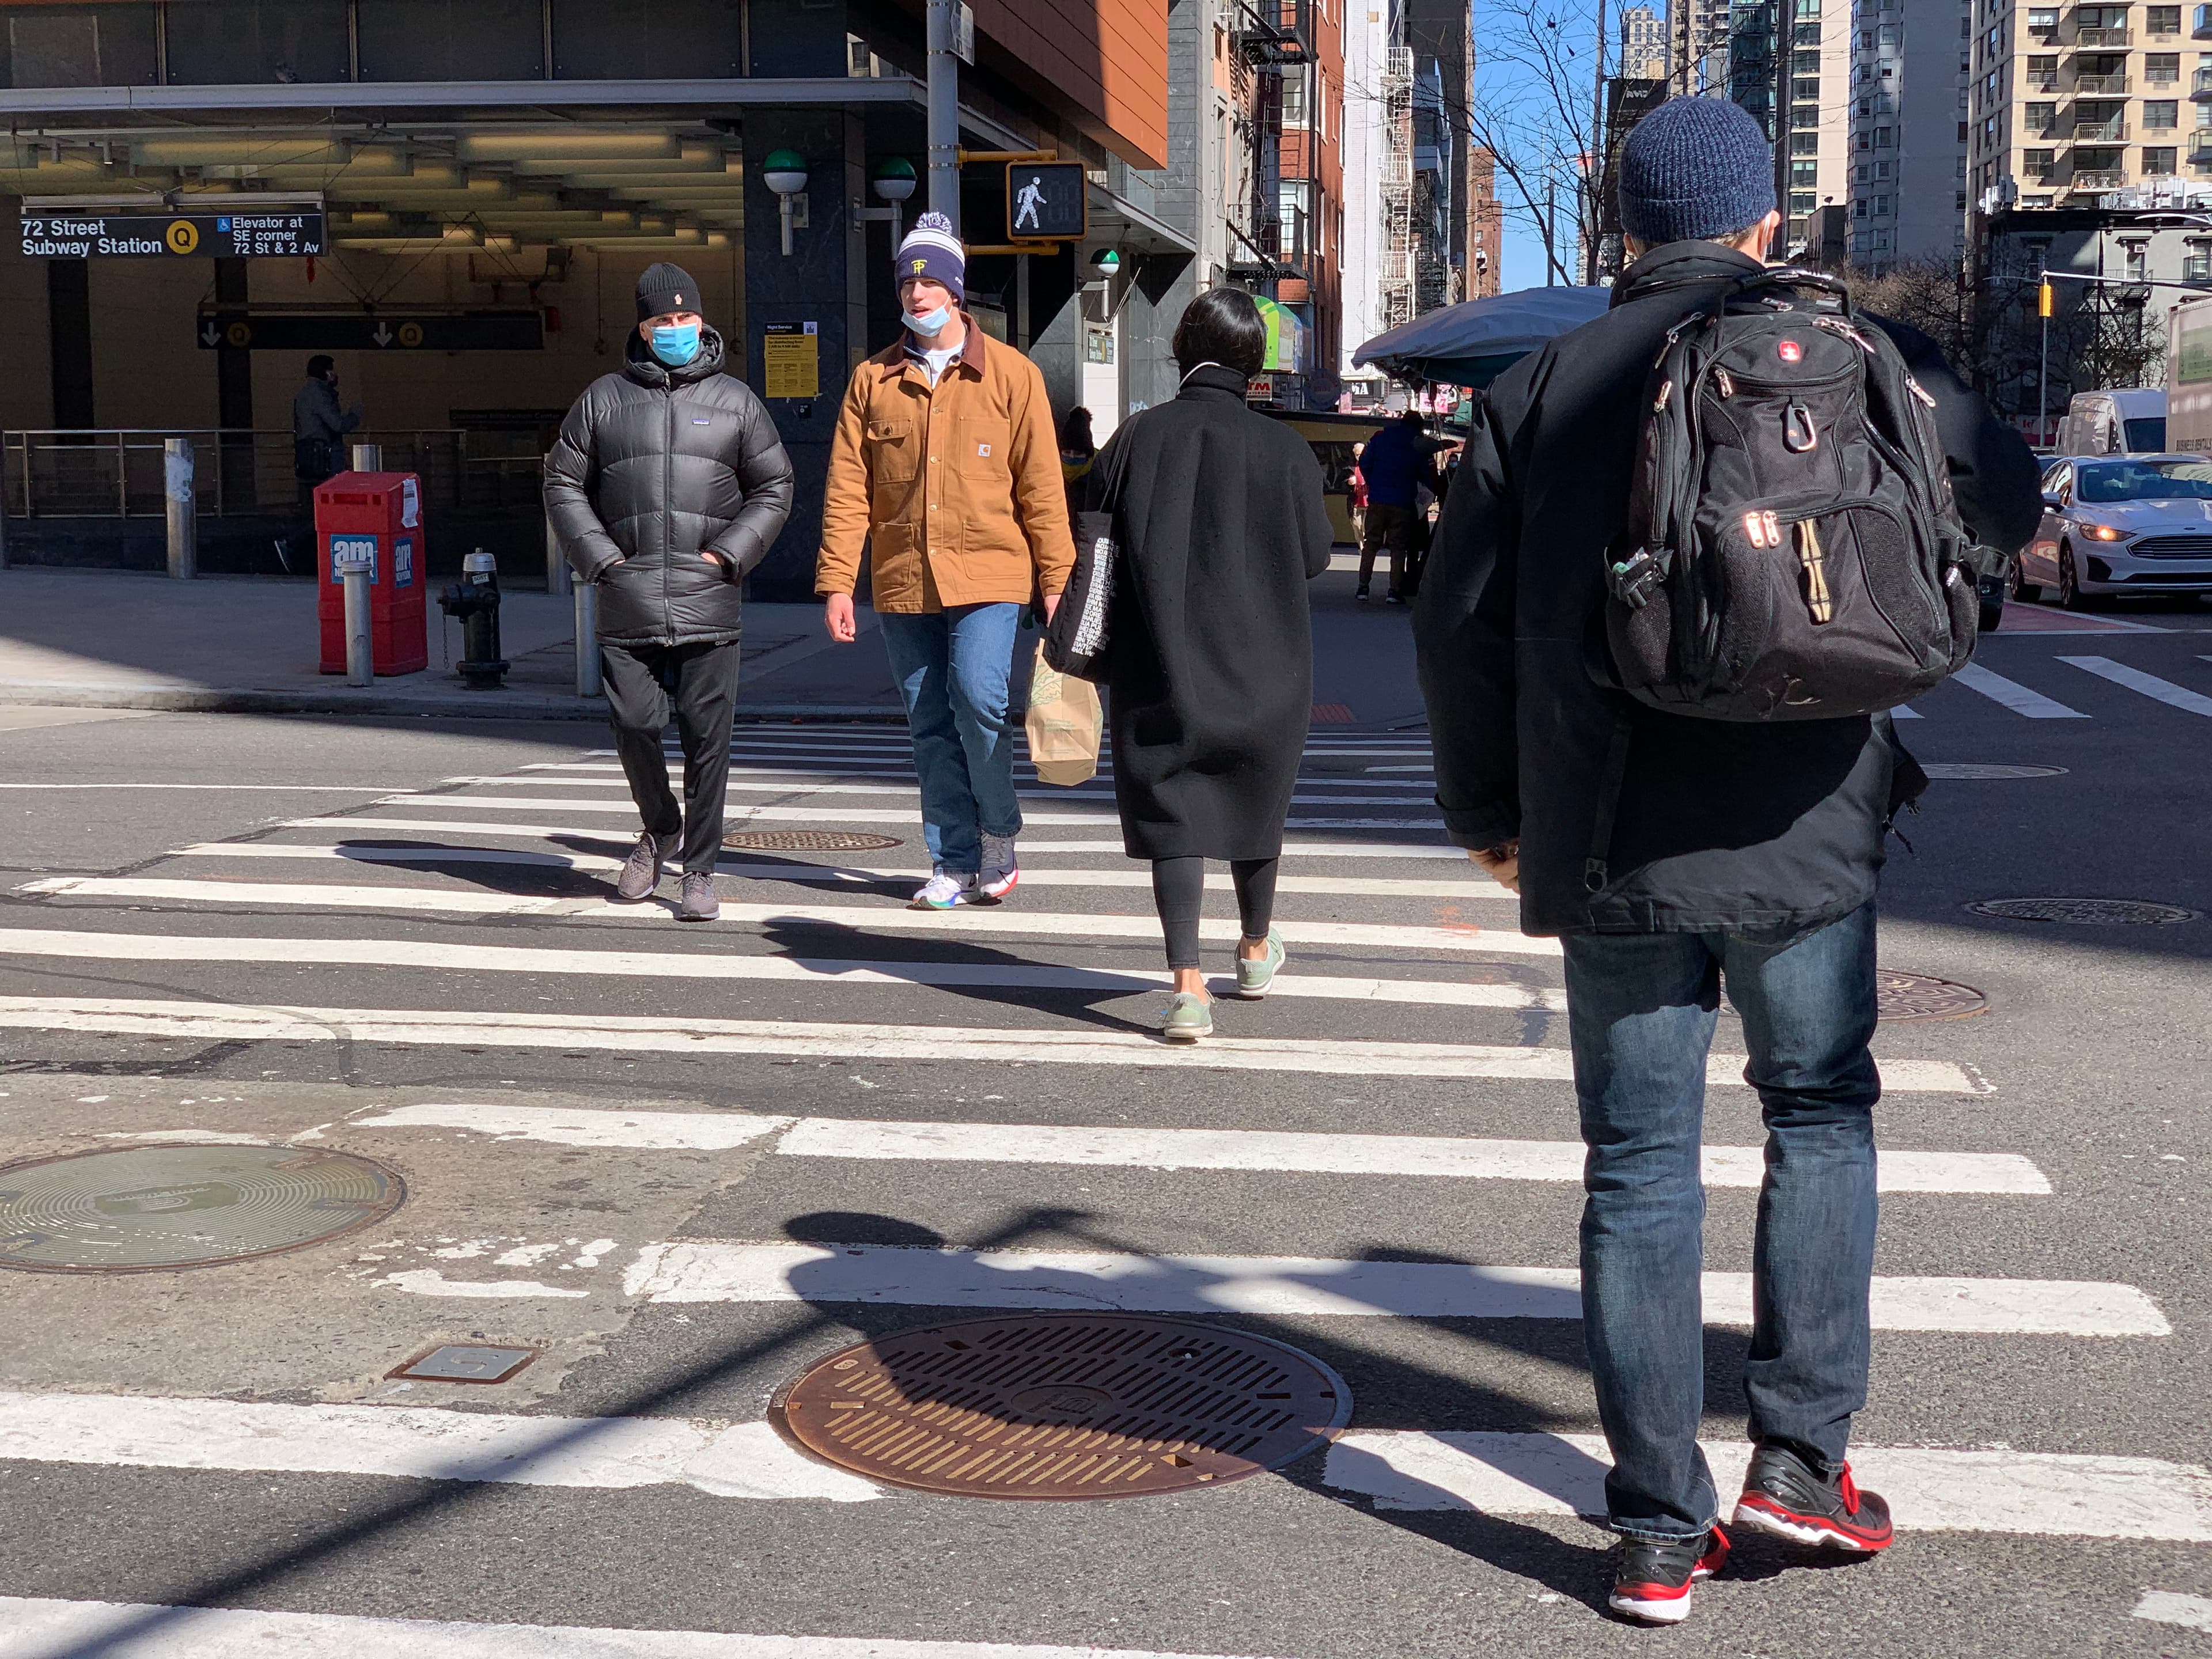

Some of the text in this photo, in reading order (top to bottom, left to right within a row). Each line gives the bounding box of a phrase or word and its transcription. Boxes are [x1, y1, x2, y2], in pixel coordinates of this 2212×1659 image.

[21, 219, 105, 236] 72 Street
[232, 217, 302, 229] Elevator at
[174, 228, 190, 247] Q
[233, 230, 296, 241] SE corner
[22, 237, 162, 257] Subway Station
[233, 242, 319, 254] 72 St & 2 Av
[1248, 381, 1270, 391] TM
